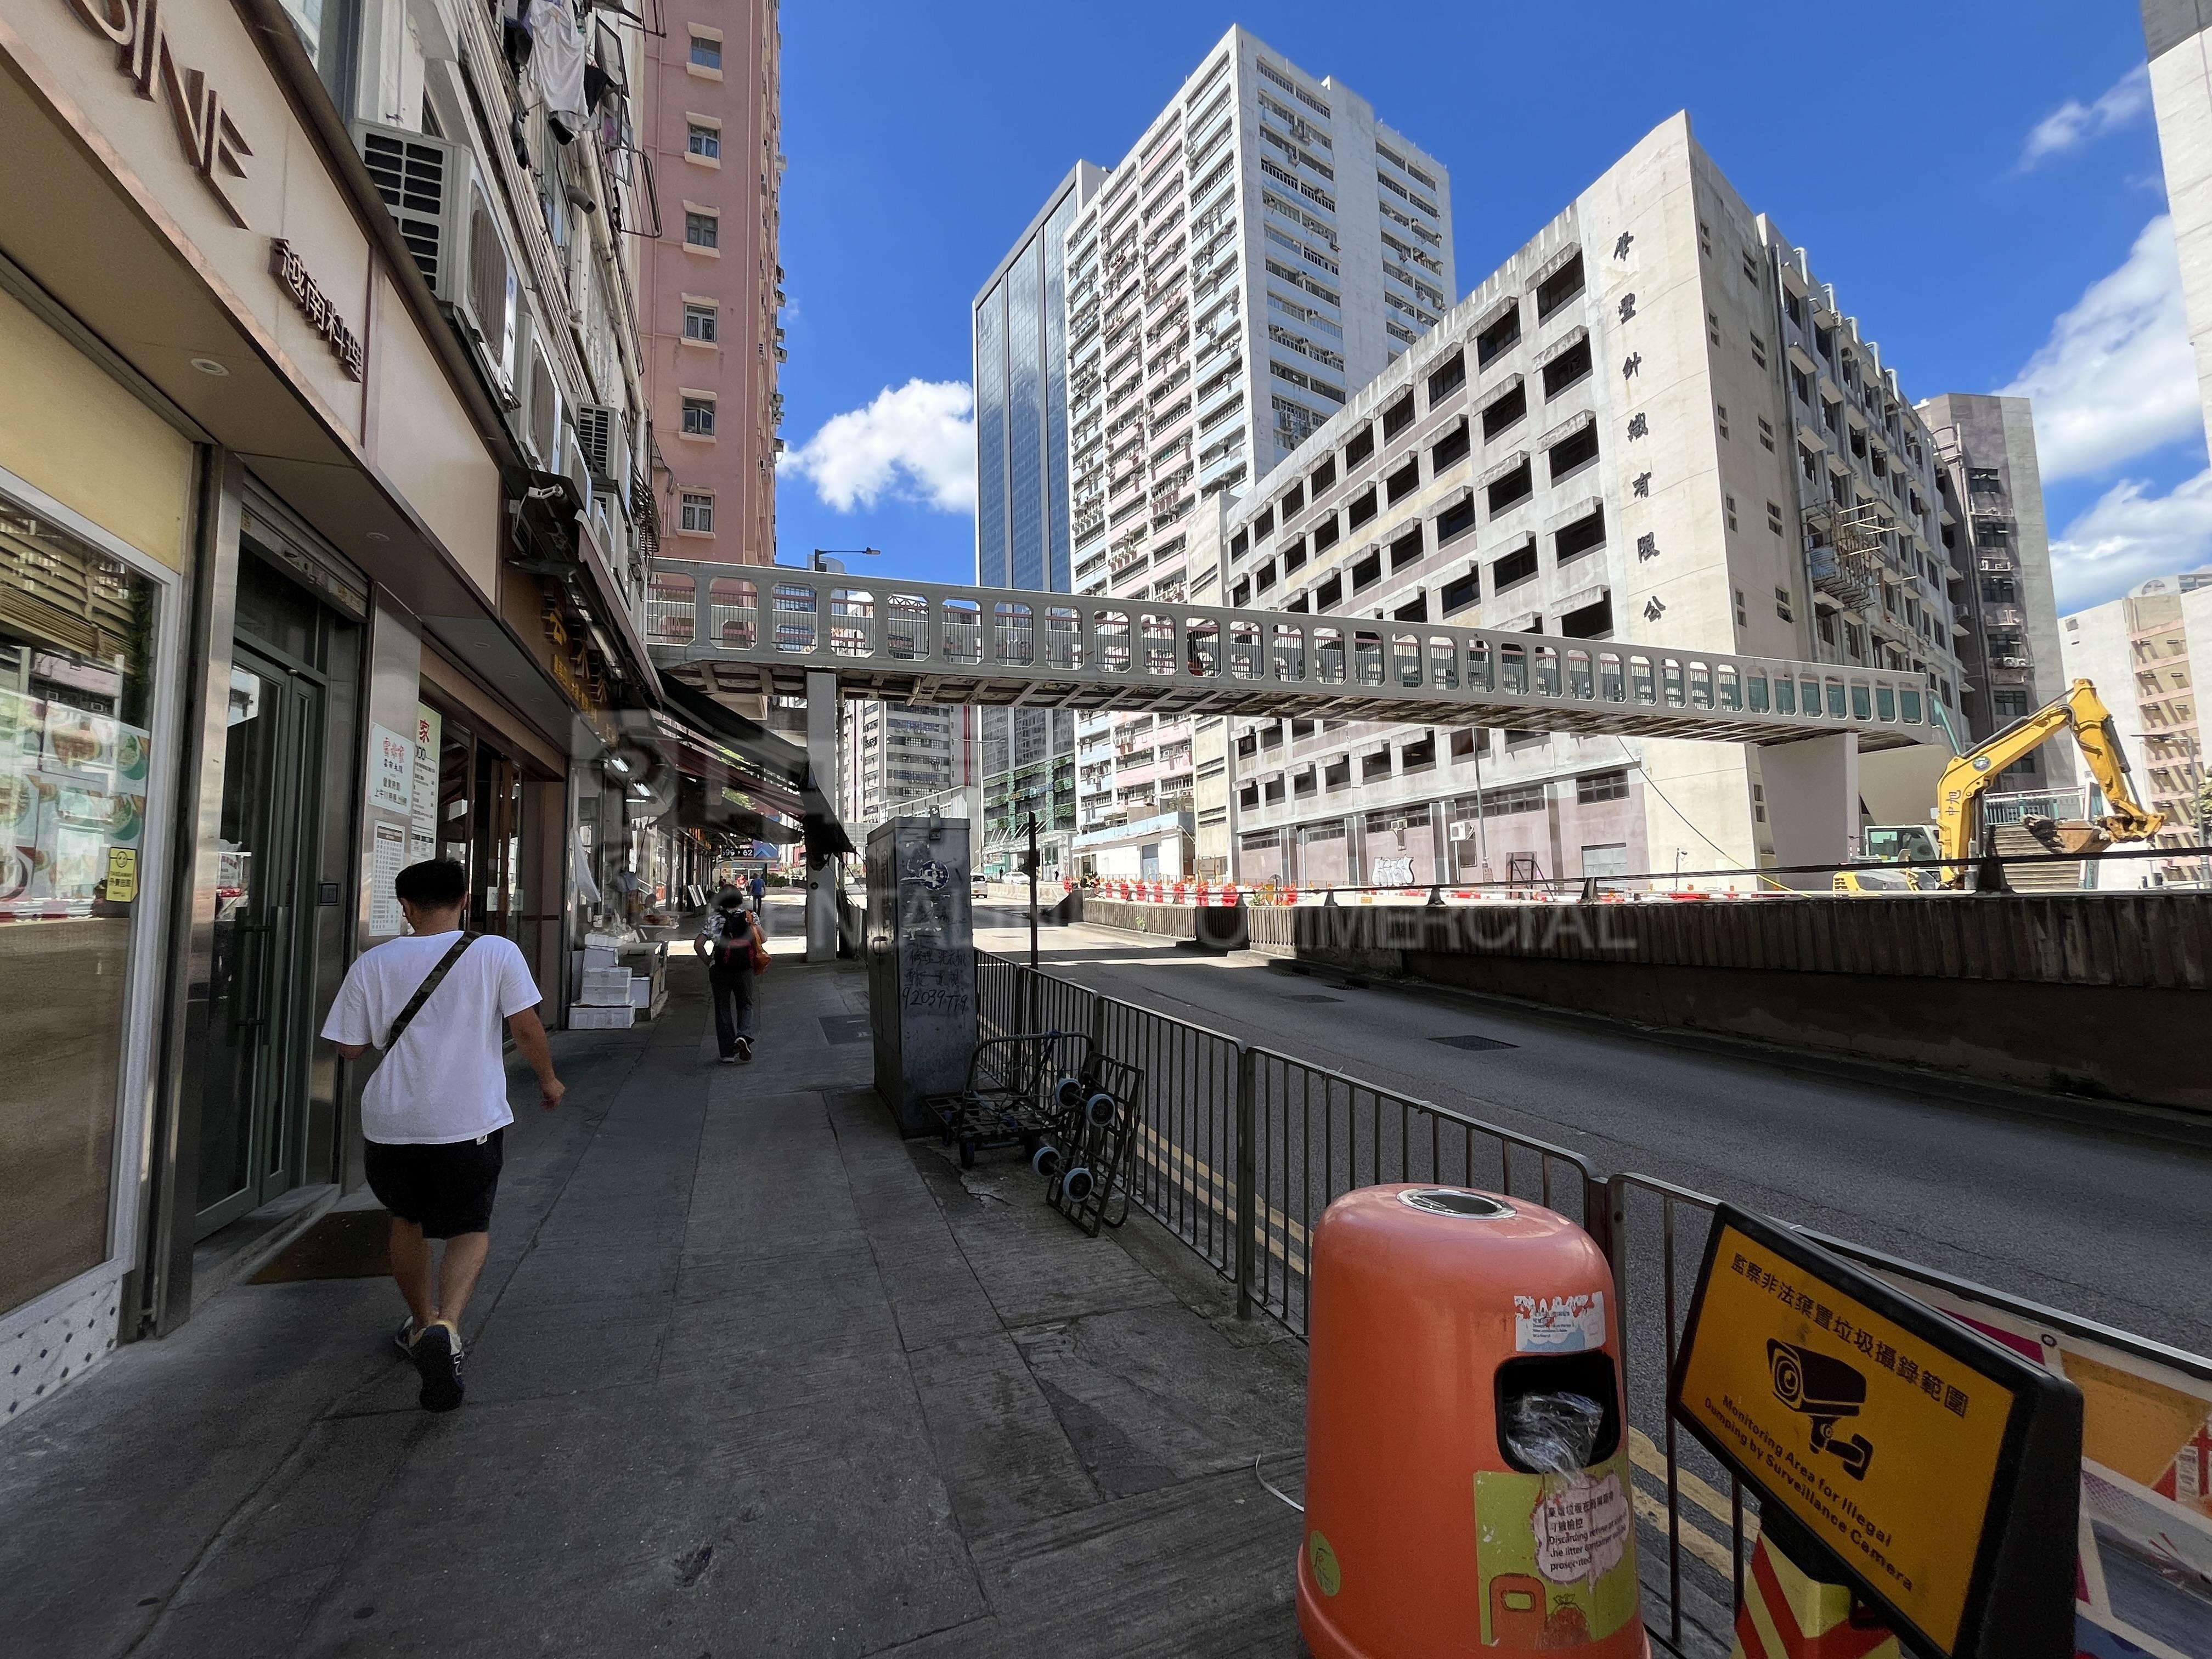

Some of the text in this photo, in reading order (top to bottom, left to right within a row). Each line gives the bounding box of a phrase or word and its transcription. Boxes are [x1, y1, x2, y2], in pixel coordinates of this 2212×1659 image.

[269, 238, 363, 382] 越南料理
[1730, 1252, 1970, 1419] 監察非法棄置垃圾攝錄範圍
[1549, 1532, 1588, 1545] Discarding
[1705, 1397, 1912, 1592] Dumping by Surveillance Camera
[1723, 1394, 1892, 1548] Monitoring Area for Illegal
[1565, 1545, 1583, 1556] litter
